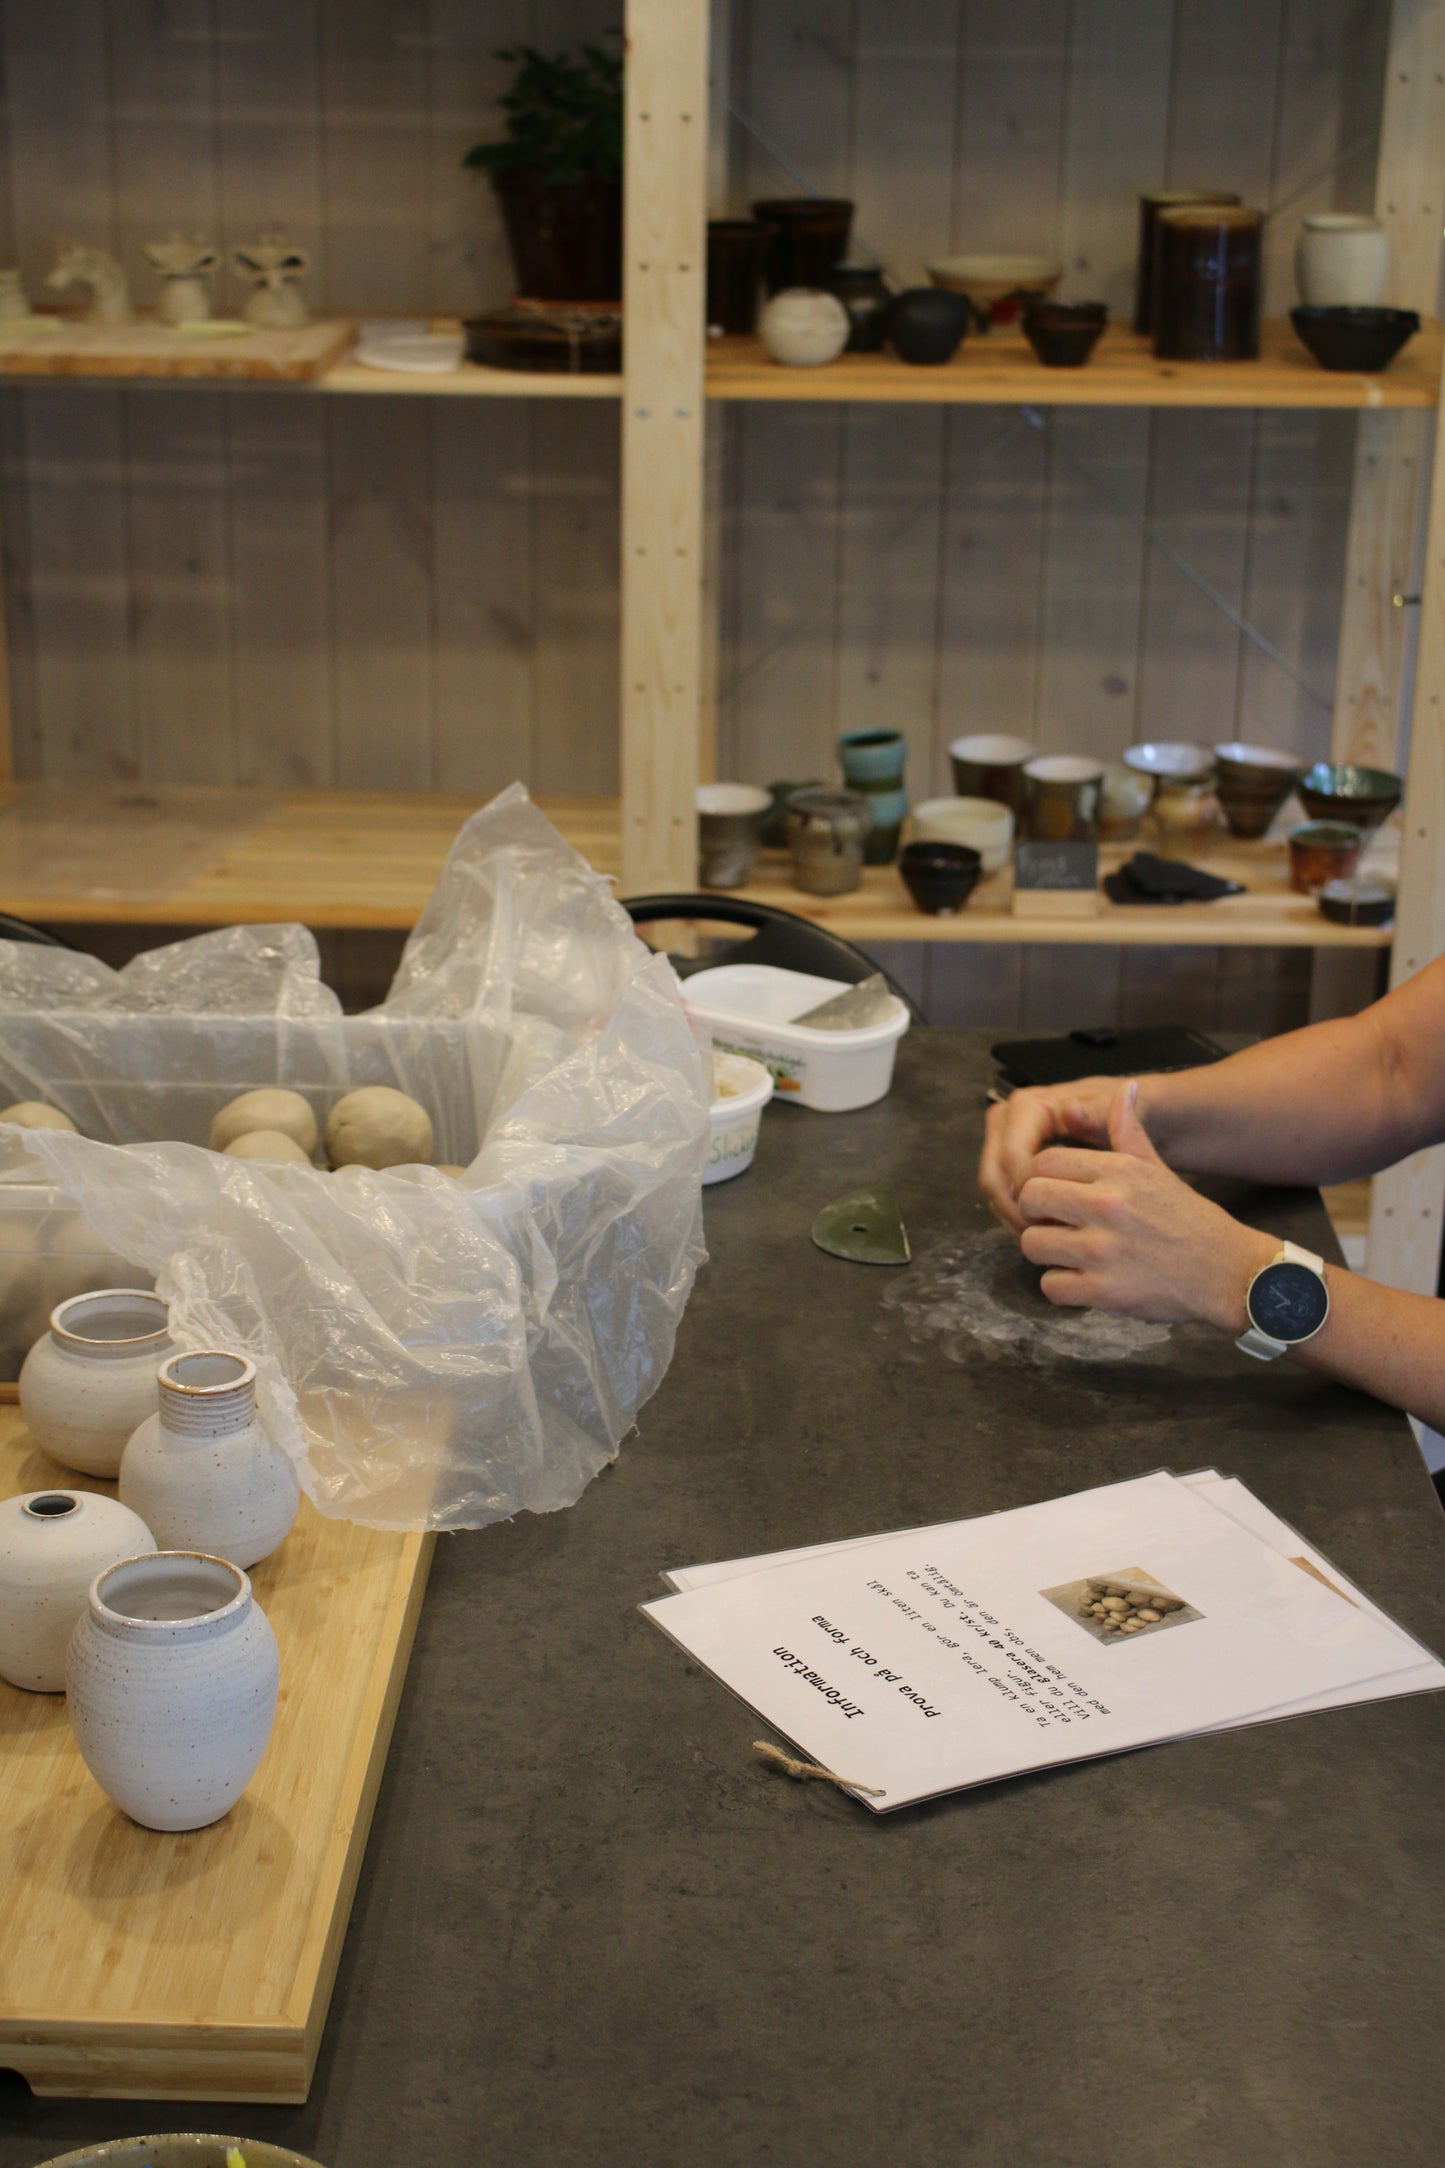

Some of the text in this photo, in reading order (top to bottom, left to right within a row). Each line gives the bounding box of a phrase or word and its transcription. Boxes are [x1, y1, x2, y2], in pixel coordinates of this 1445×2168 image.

[772, 1646, 865, 1719] Information
[811, 1615, 942, 1718] Prova på och forma
[866, 1580, 1051, 1728] Ta en klump lera, gör en liten skål
[906, 1570, 1091, 1720] Vill du glasera 40 kr/st. Du kan ta
[924, 1563, 1111, 1715] med den hem men obs, den är ömtålig.
[1007, 1669, 1072, 1723] eller figur.
